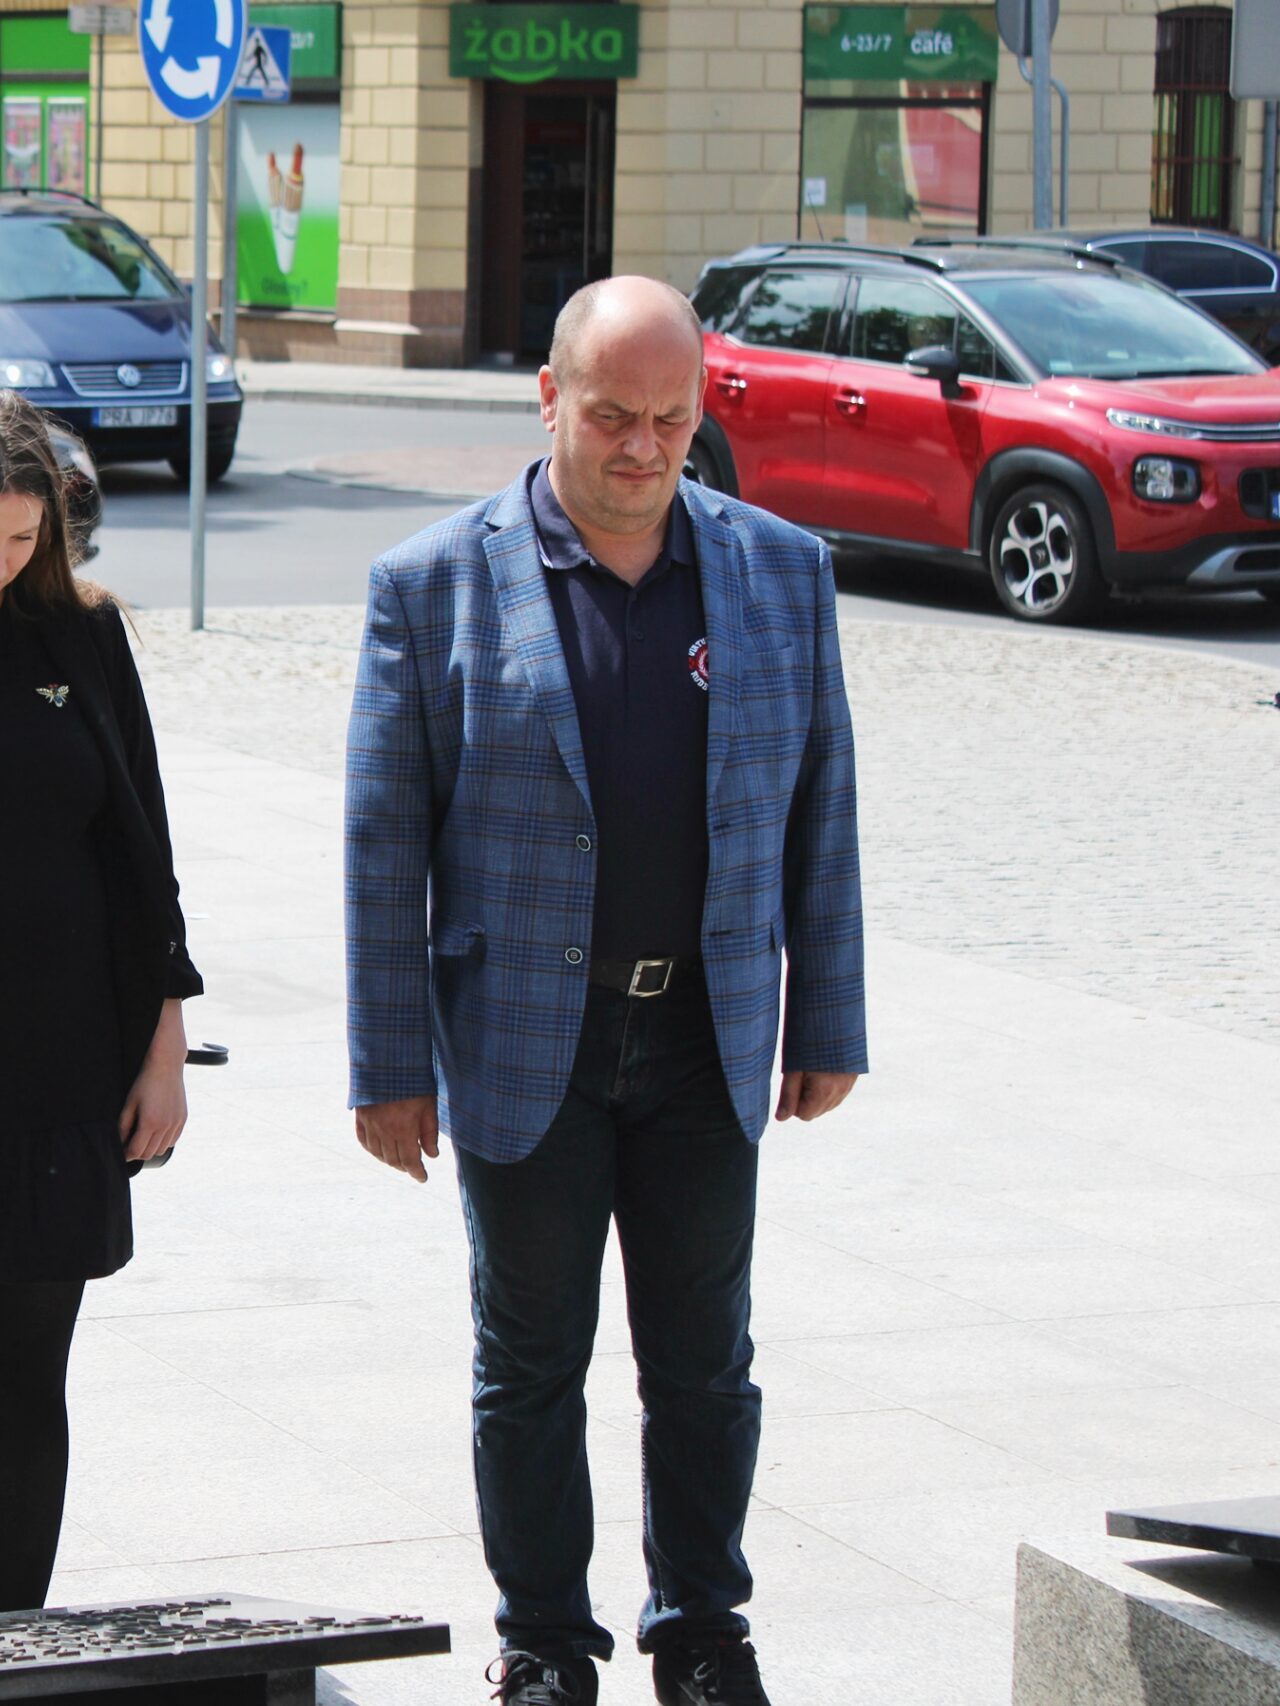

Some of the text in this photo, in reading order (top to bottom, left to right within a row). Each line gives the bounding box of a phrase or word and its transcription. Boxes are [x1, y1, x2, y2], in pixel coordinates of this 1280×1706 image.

[463, 18, 623, 62] żabka
[911, 31, 953, 54] café
[688, 638, 707, 657] VIRTU
[690, 670, 709, 691] RUDE
